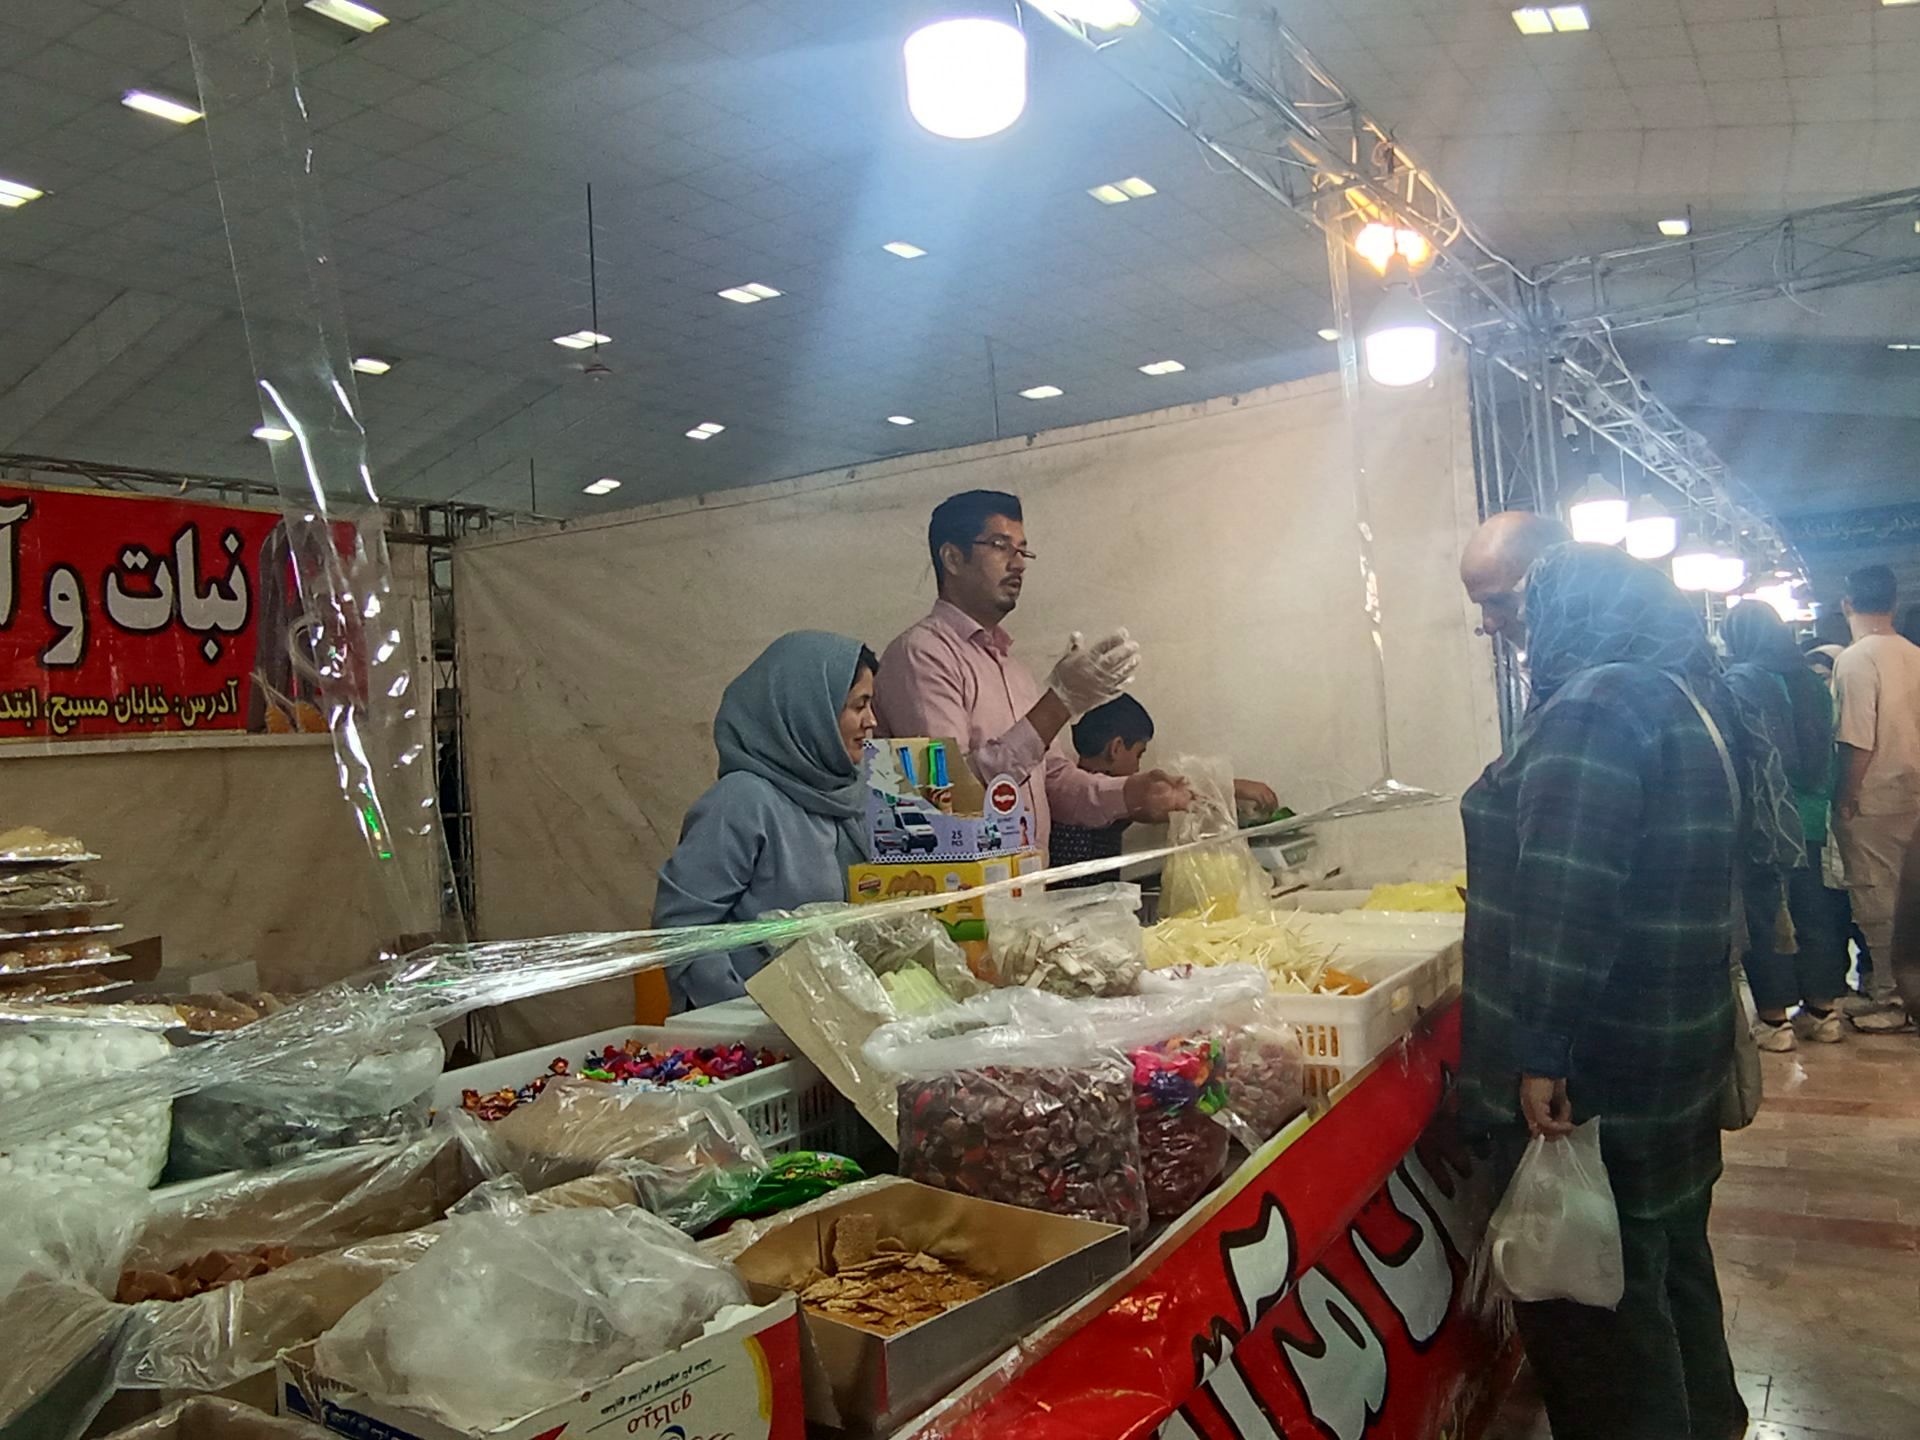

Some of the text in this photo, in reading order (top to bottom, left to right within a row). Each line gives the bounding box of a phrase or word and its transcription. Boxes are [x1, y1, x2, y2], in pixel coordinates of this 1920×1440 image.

[0, 502, 249, 665] نبات و آ
[0, 688, 38, 728] ابتد
[113, 686, 170, 724] خیابان
[174, 680, 239, 727] آدرس:
[951, 830, 963, 840] 25
[627, 1388, 693, 1434] میکادو
